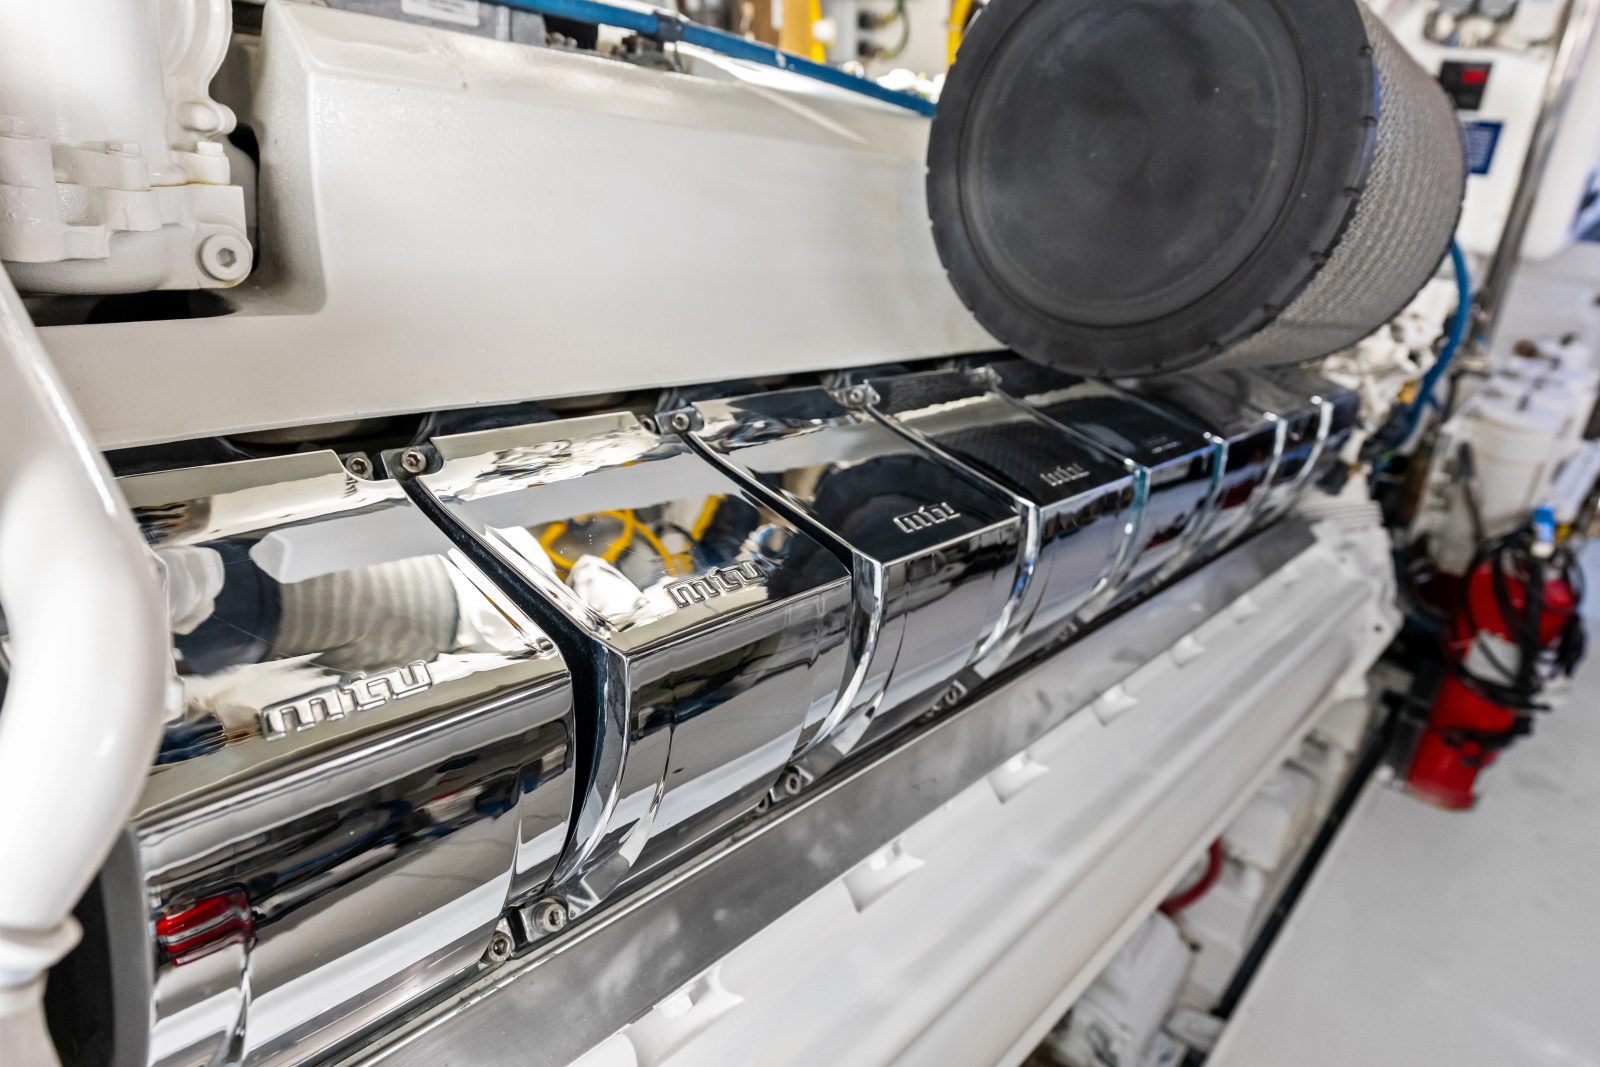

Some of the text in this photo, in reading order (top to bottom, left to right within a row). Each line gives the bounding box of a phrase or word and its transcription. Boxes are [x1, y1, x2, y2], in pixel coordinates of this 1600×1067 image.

[893, 502, 961, 534] mtu
[664, 560, 766, 608] mtu
[259, 660, 433, 741] mtu
